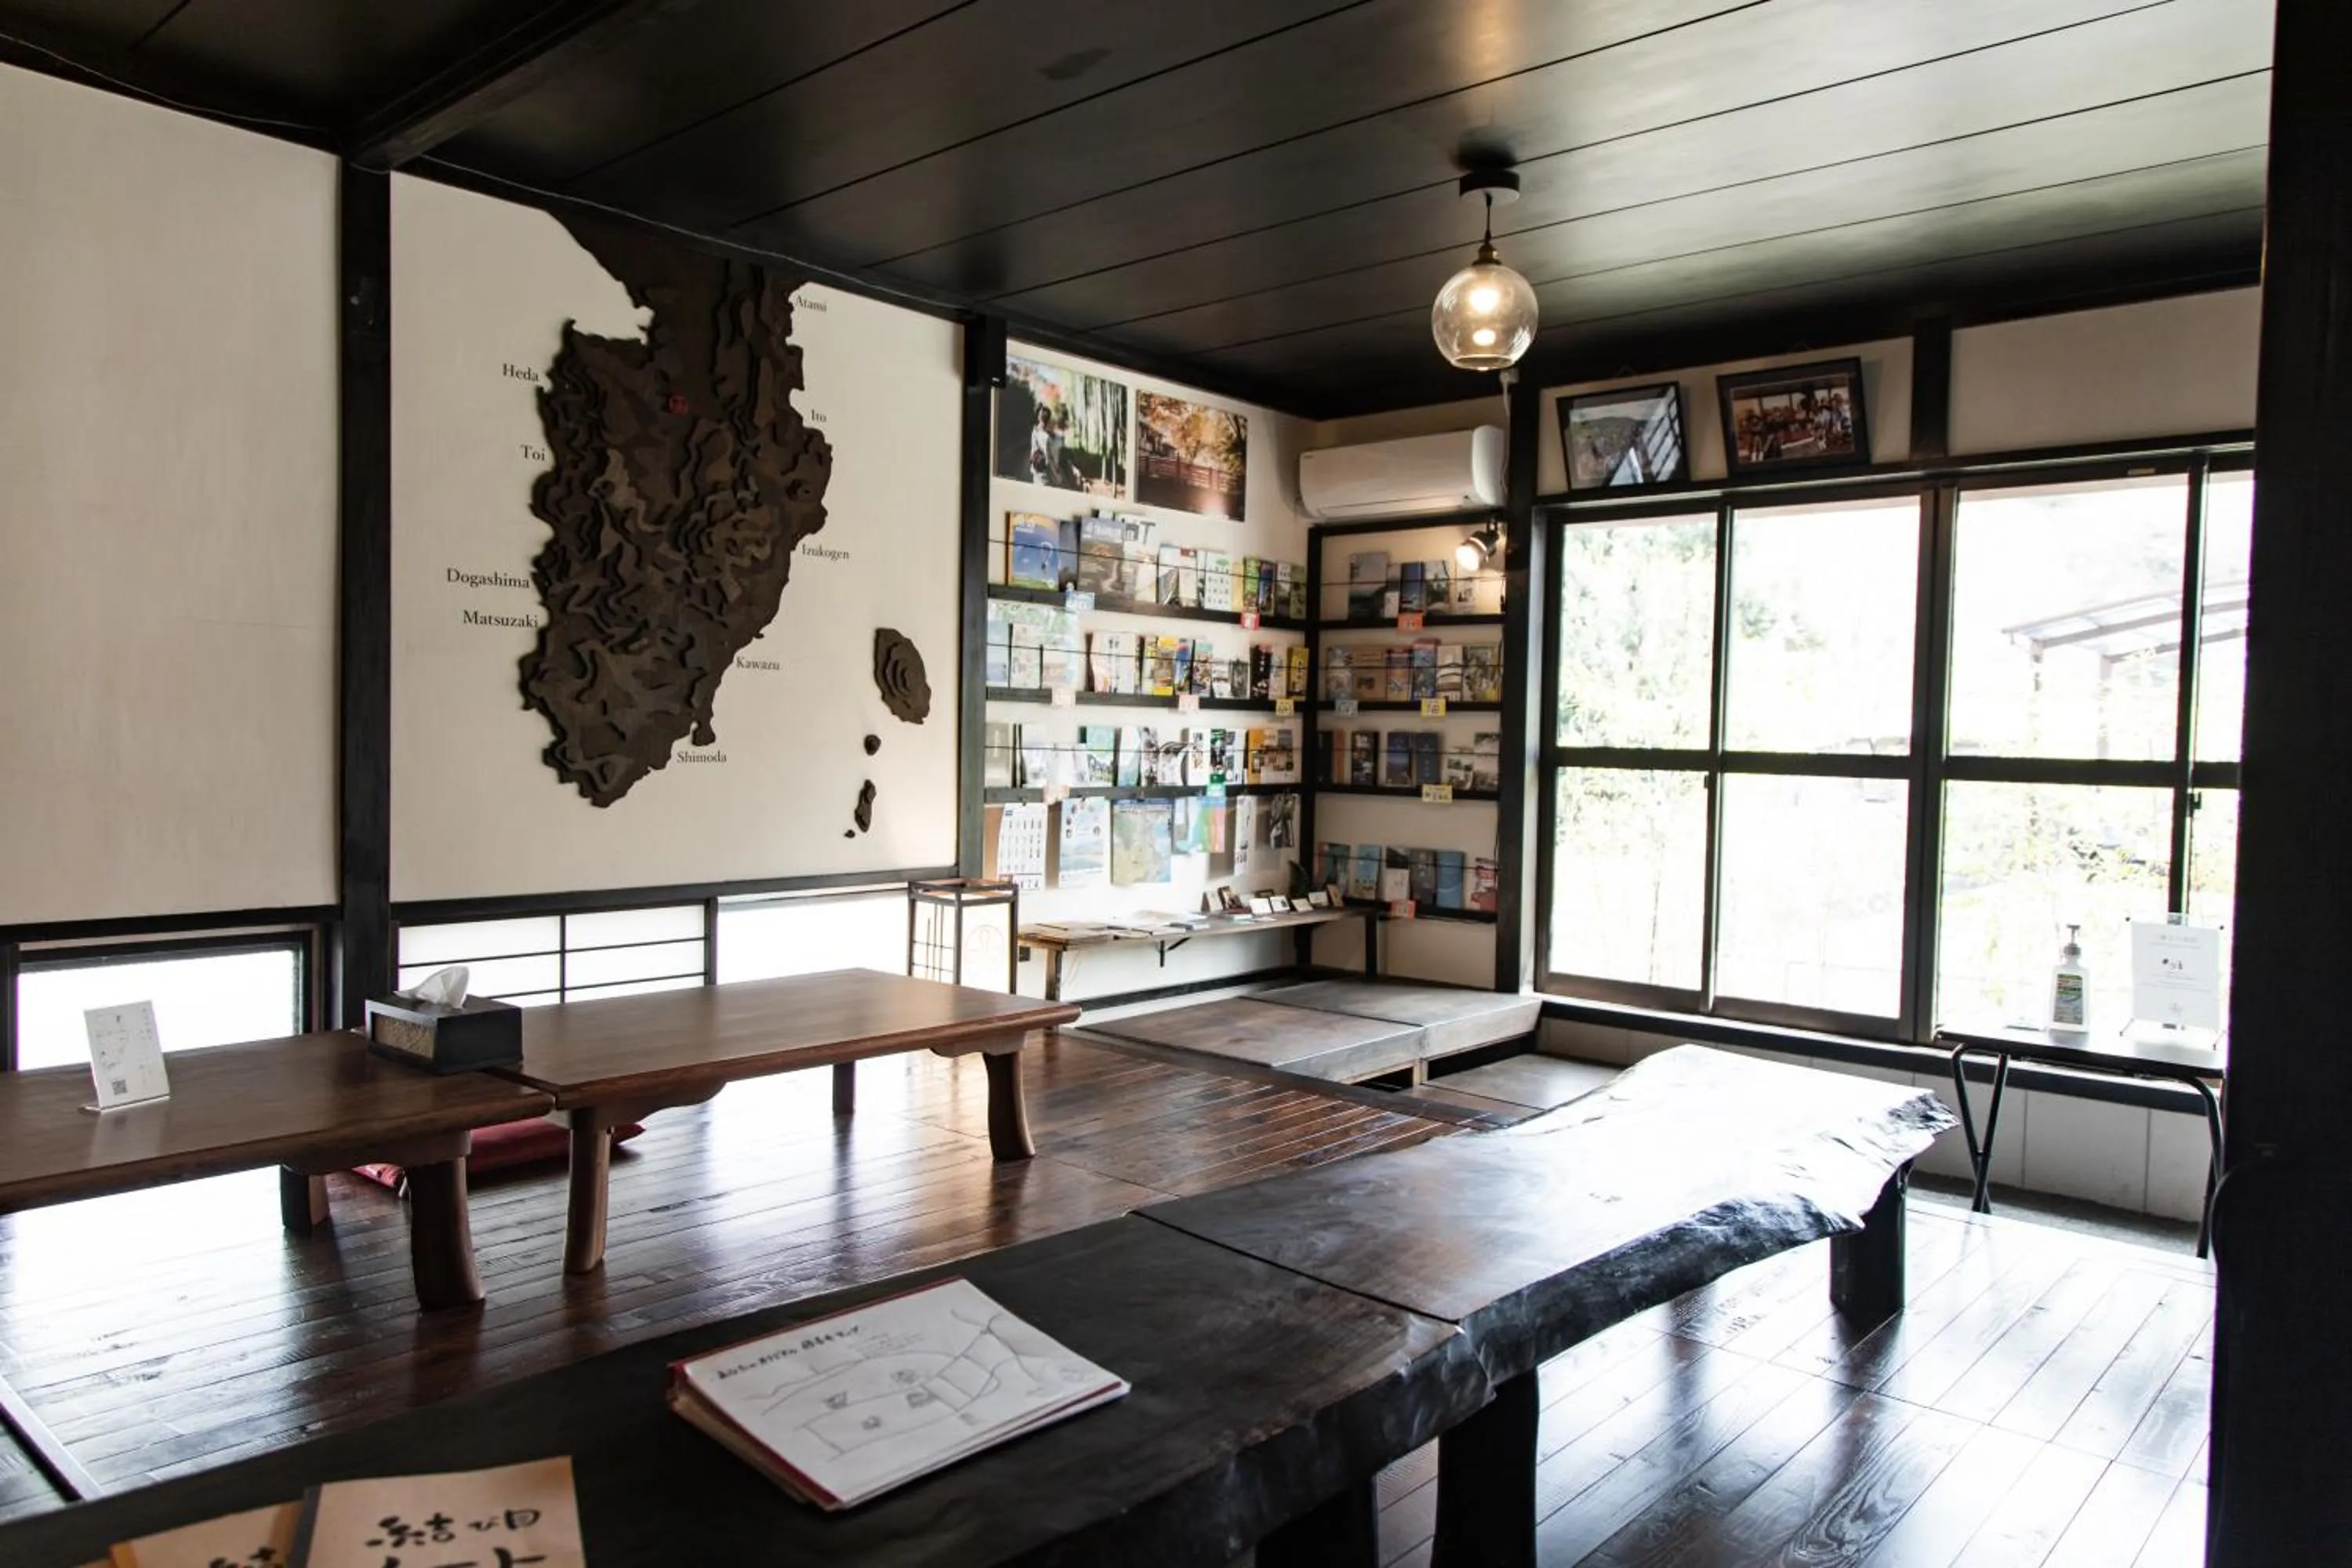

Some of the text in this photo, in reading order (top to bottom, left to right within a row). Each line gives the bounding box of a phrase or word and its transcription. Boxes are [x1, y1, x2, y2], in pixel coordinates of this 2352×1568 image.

[794, 295, 827, 313] Atami
[503, 363, 539, 383] Heda
[811, 408, 827, 423] Ito
[521, 444, 546, 463] Toi
[800, 543, 851, 561] Izukogen
[446, 568, 531, 591] Dogashima
[463, 609, 539, 629] Matsuzaki
[735, 655, 781, 671] Kawazu
[677, 750, 728, 764] Shimoda
